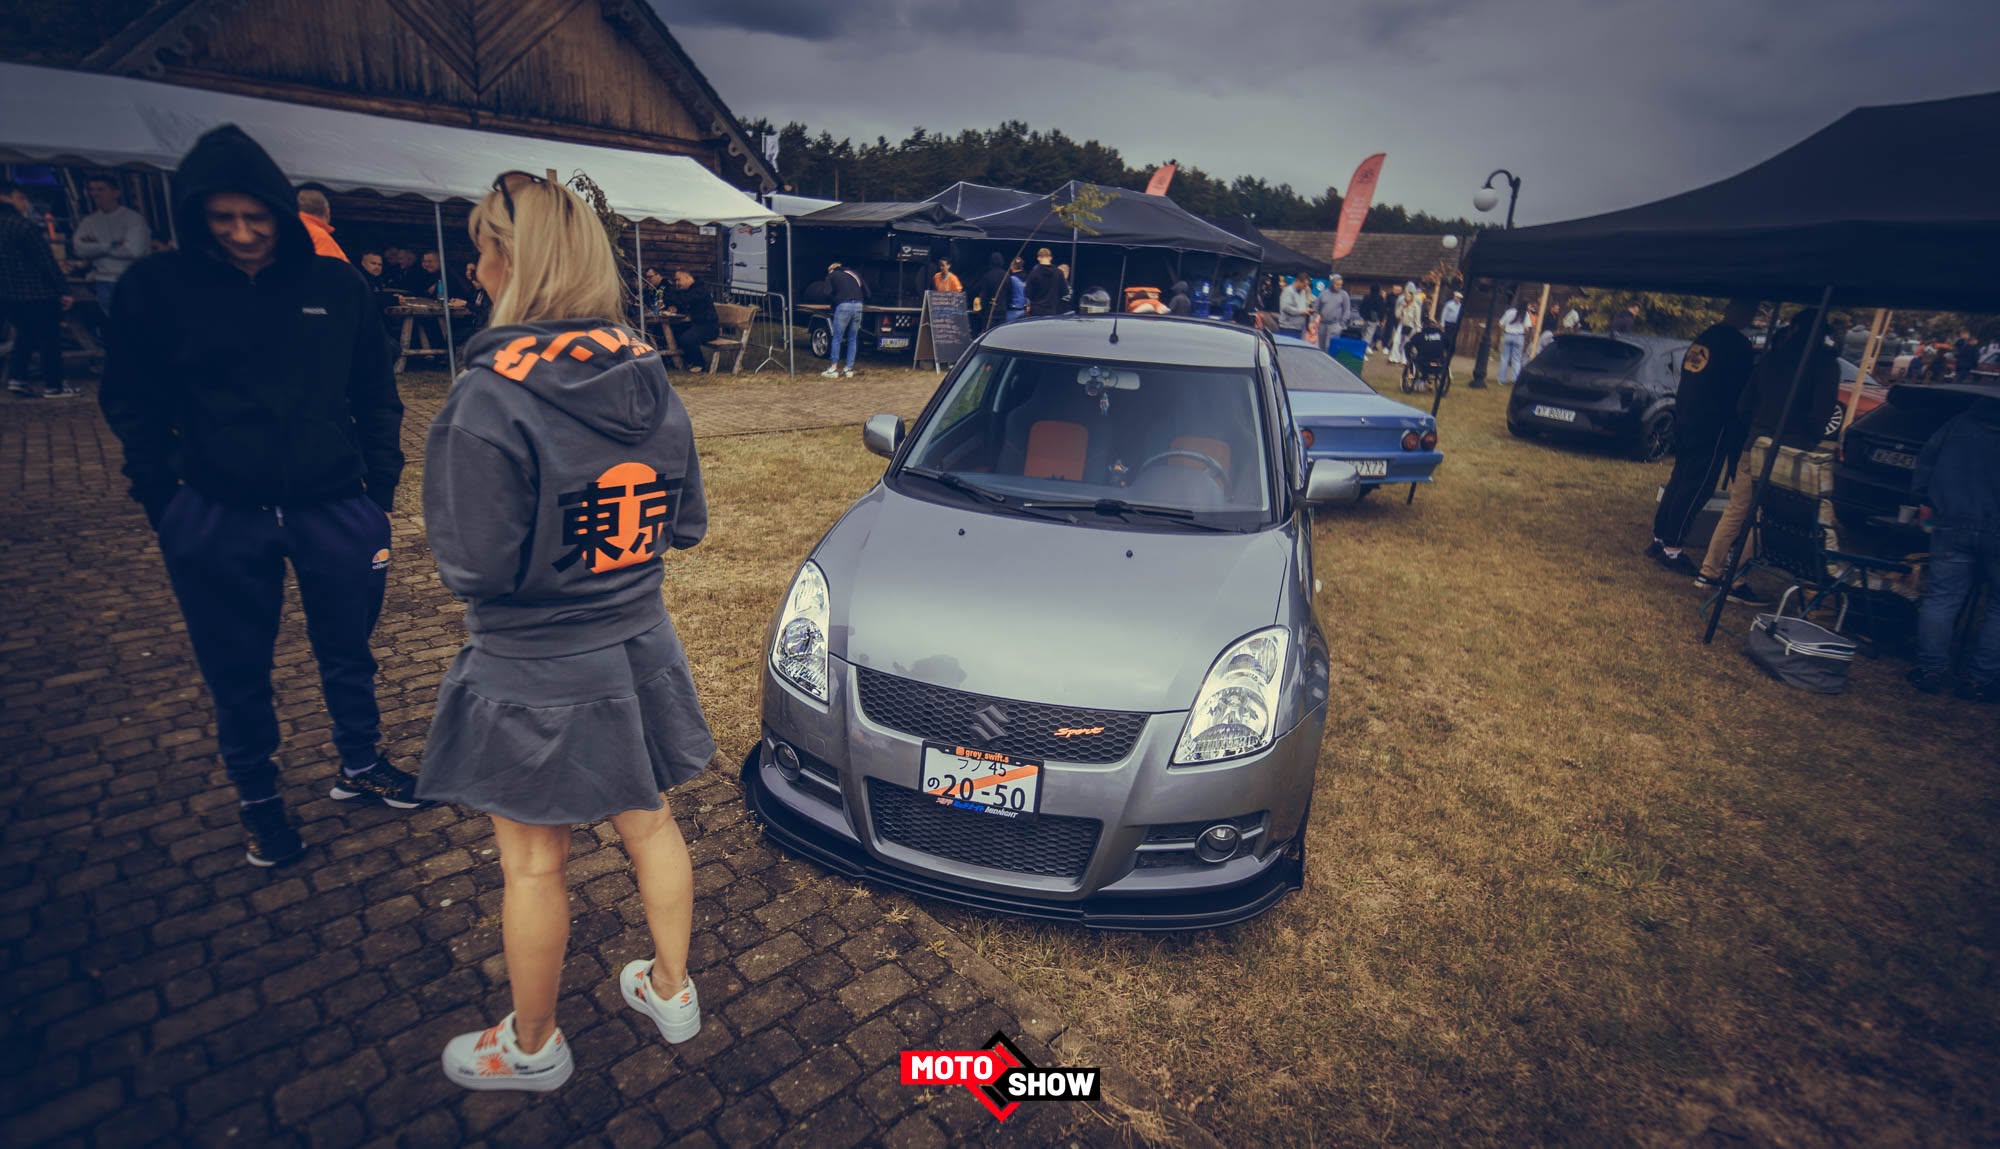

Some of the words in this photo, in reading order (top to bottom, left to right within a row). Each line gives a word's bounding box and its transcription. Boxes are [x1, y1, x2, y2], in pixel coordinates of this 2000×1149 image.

[552, 473, 687, 572] 東京
[1053, 727, 1105, 739] Sport
[988, 761, 1007, 777] 45
[941, 774, 1026, 811] 20-50
